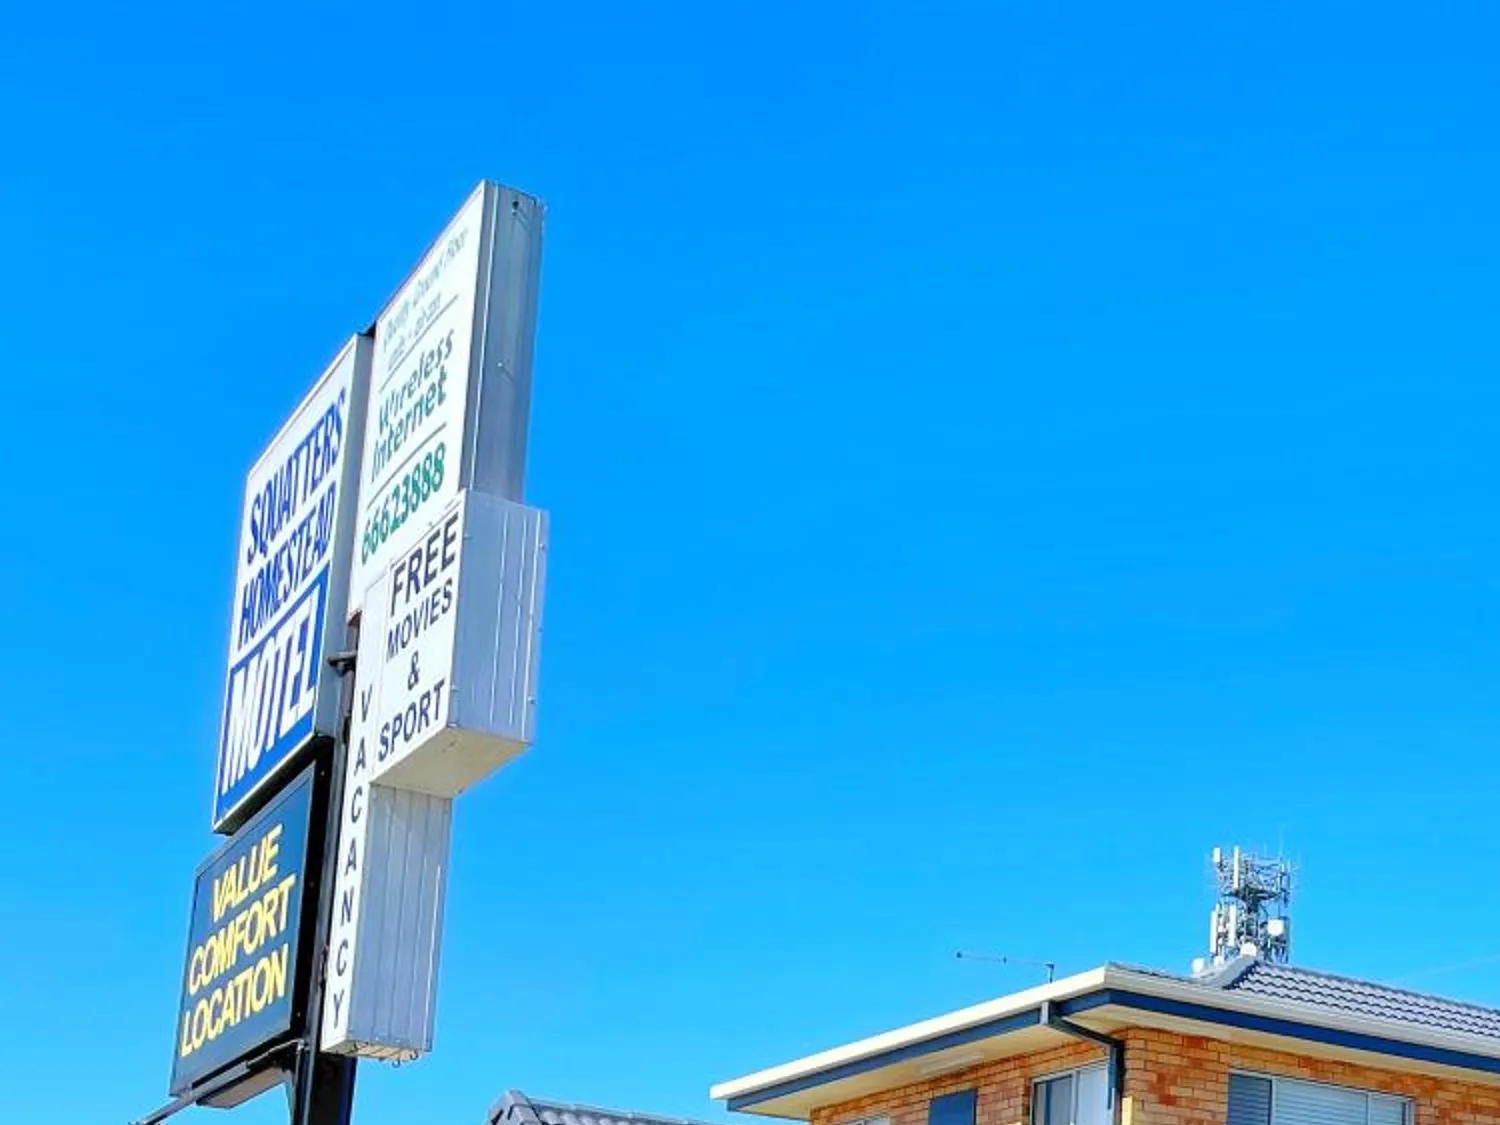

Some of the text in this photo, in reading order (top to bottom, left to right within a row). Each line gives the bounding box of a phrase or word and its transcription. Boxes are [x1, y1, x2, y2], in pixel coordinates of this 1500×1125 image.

[372, 366, 448, 483] Internet
[378, 328, 455, 436] Wireless
[247, 387, 346, 564] SQUATTERS
[362, 441, 447, 566] 66623888
[238, 480, 336, 653] HOMESTEAD
[387, 577, 454, 662] MOVIES
[390, 513, 459, 617] FREE
[221, 582, 320, 797] MOTEL
[378, 678, 446, 763] SPORT
[407, 650, 420, 691] &
[212, 823, 284, 922] VALUE
[331, 684, 373, 1028] VACANCY
[189, 873, 296, 996] COMFORT
[181, 943, 289, 1057] LOCATION
